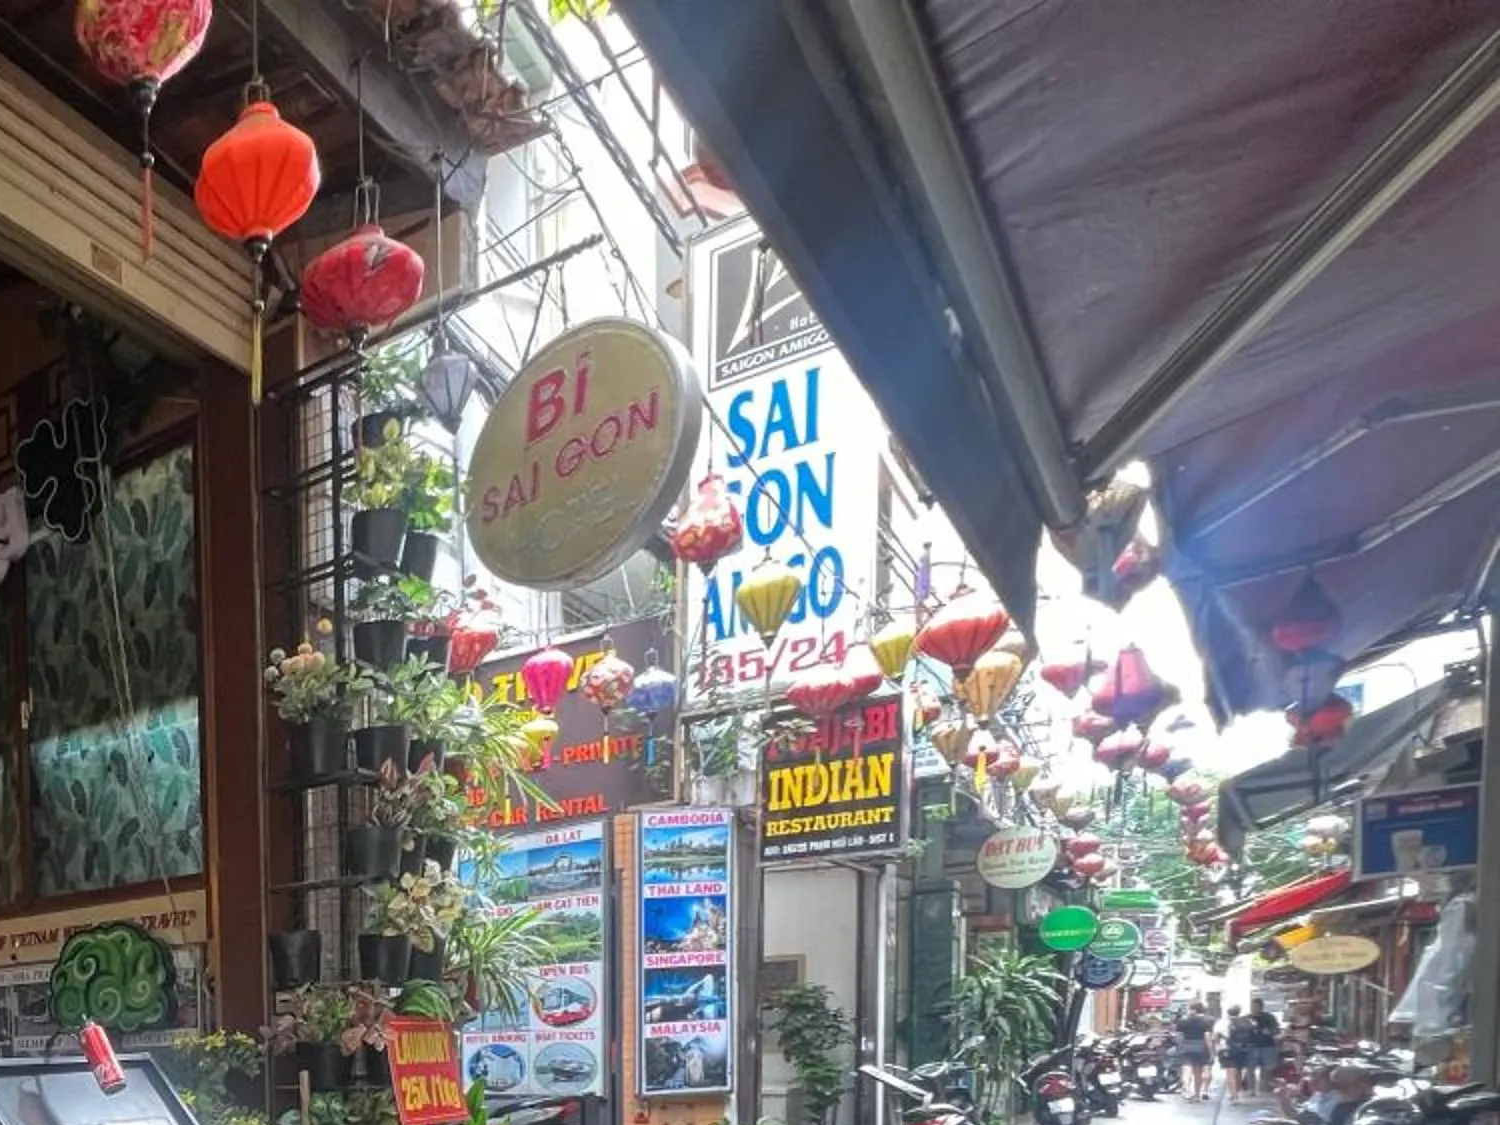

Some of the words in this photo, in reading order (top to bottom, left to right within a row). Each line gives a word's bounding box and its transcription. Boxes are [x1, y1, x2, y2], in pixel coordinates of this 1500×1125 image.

[721, 347, 775, 378] SAIGON
[779, 328, 830, 358] AMIGO
[726, 367, 821, 468] SAI
[726, 452, 837, 547] ON
[704, 545, 845, 641] AGO
[766, 703, 898, 760] NJABI
[768, 752, 895, 812] INDIAN
[489, 807, 529, 828] CR
[647, 813, 725, 826] CAMBODIA
[765, 806, 896, 838] RESTAURANT
[645, 953, 725, 966] SINGAPORE
[650, 1022, 722, 1035] MALAYSIA
